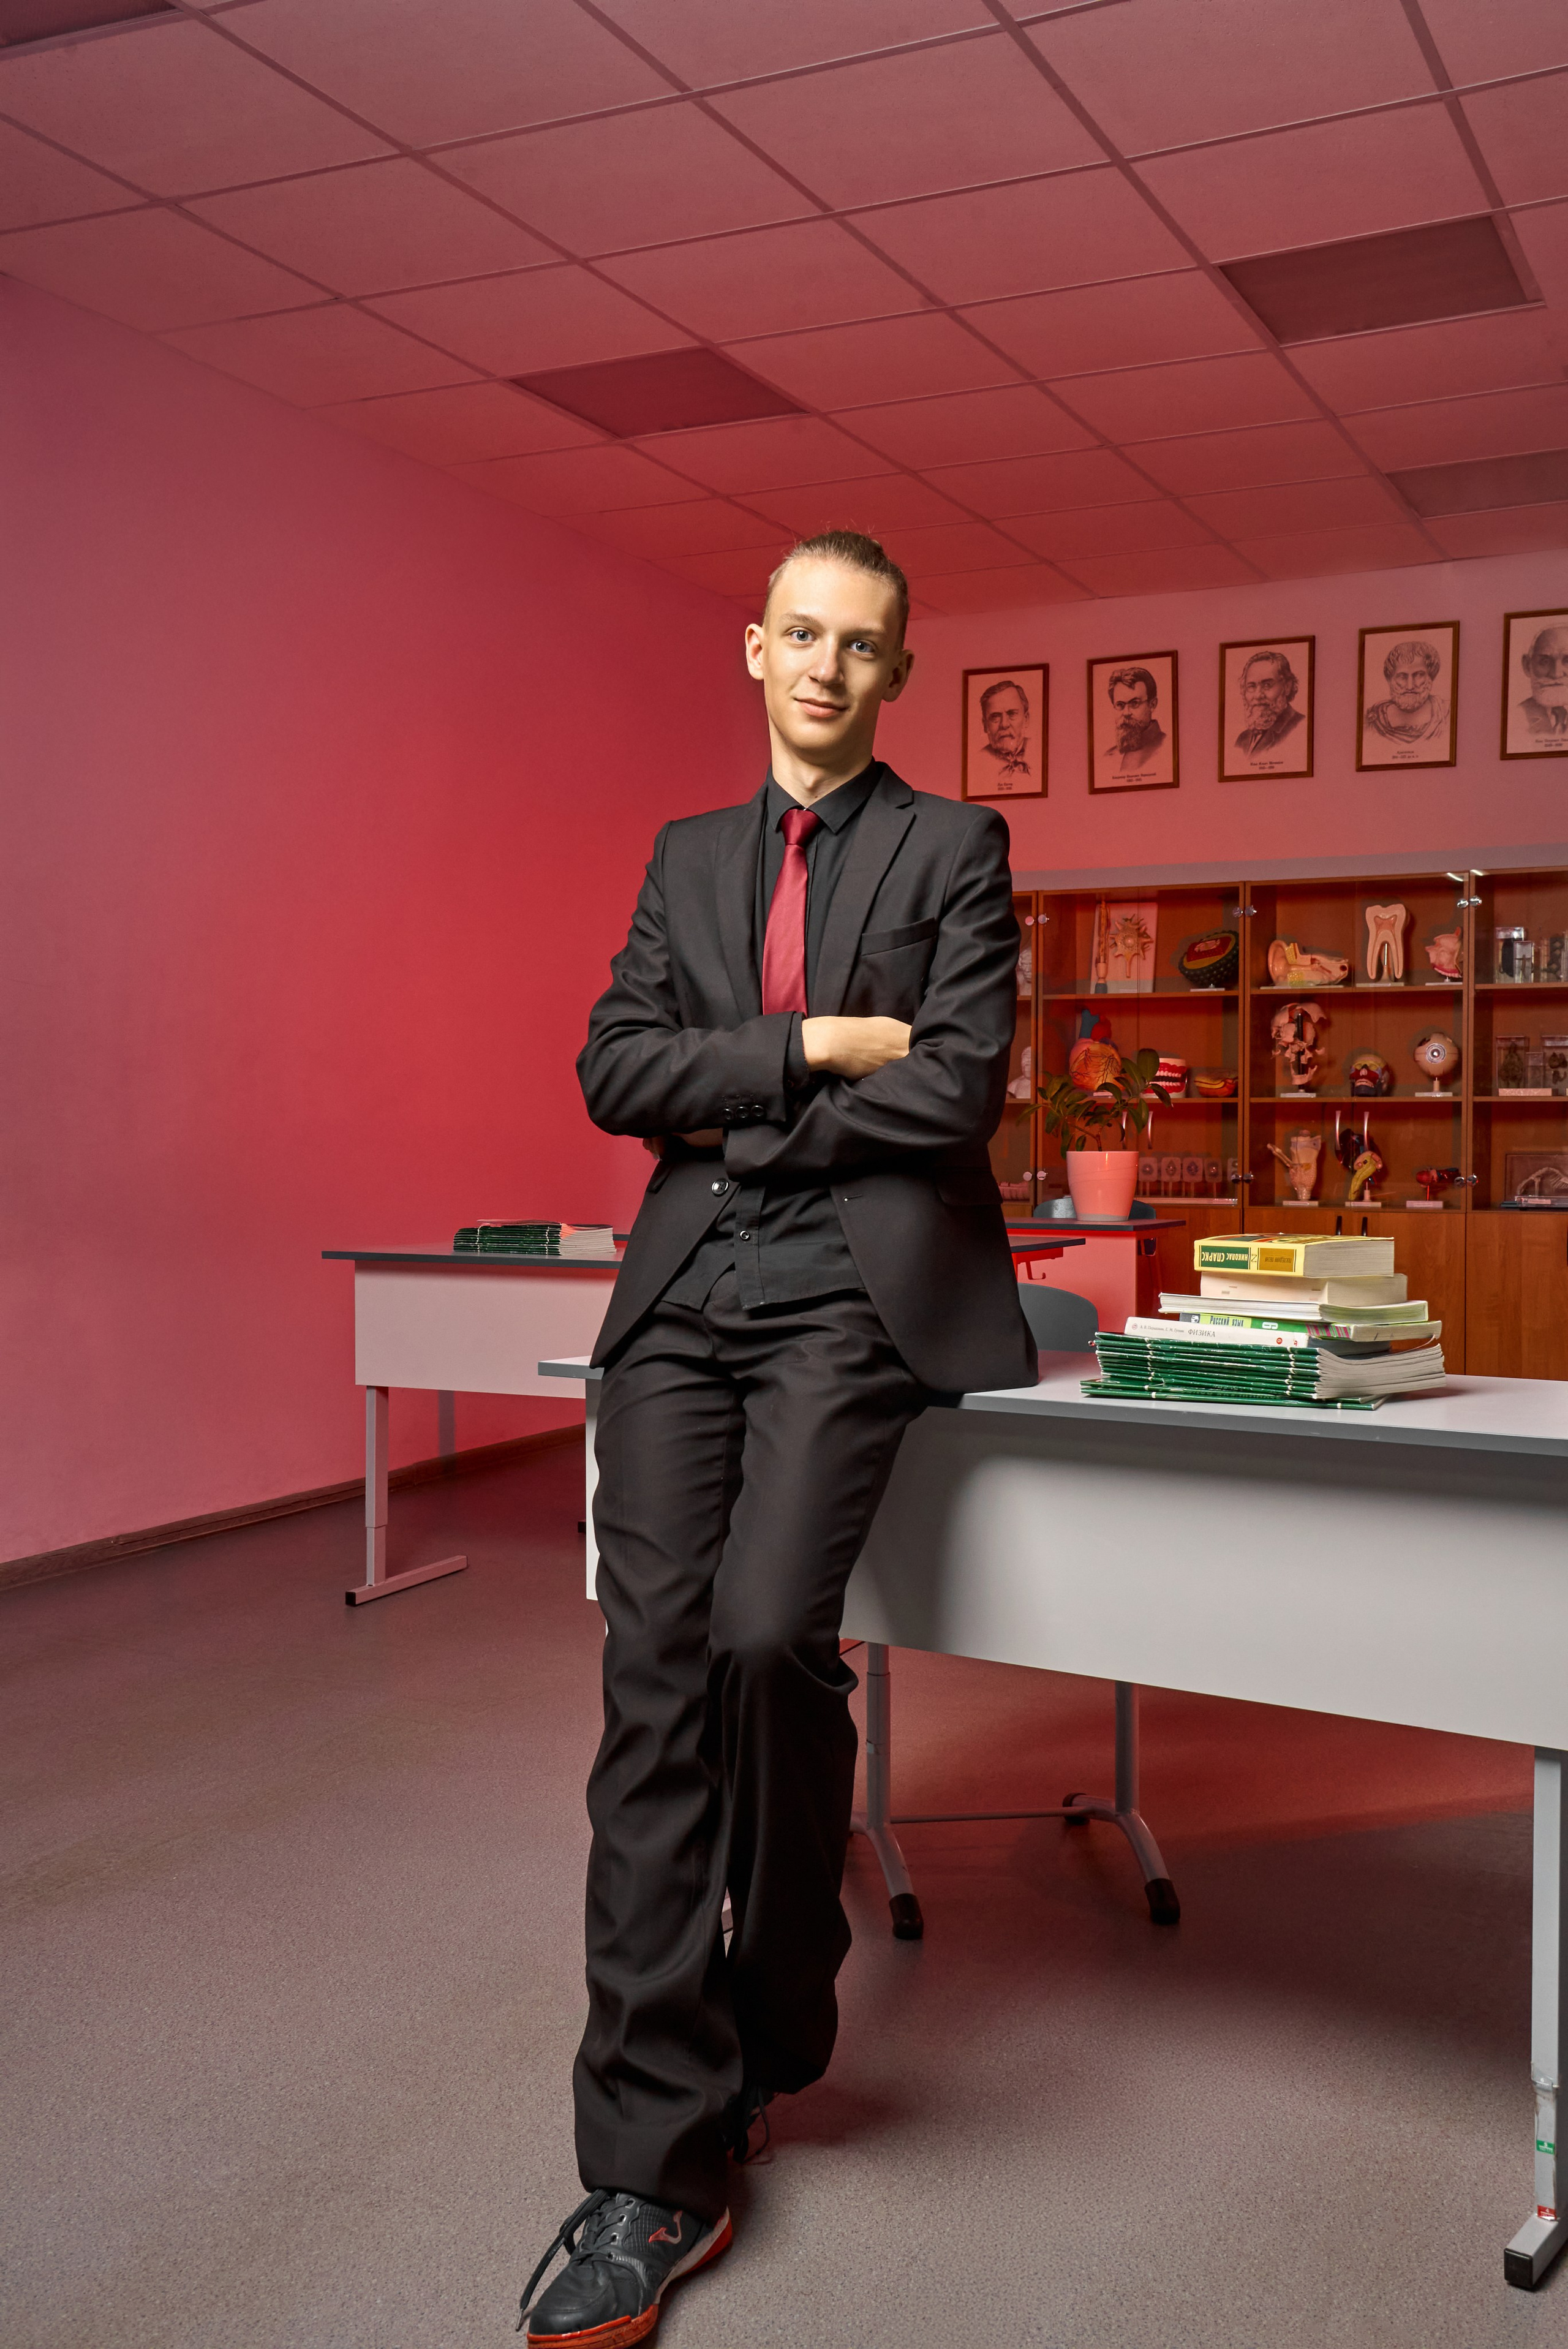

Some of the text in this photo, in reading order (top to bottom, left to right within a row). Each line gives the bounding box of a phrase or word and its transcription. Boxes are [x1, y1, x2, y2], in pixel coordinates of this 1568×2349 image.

[1201, 1251, 1248, 1262] НИКОЛАС СПАРКС
[1210, 1315, 1229, 1325] Русский
[1188, 1329, 1216, 1338] ФИЗИКА
